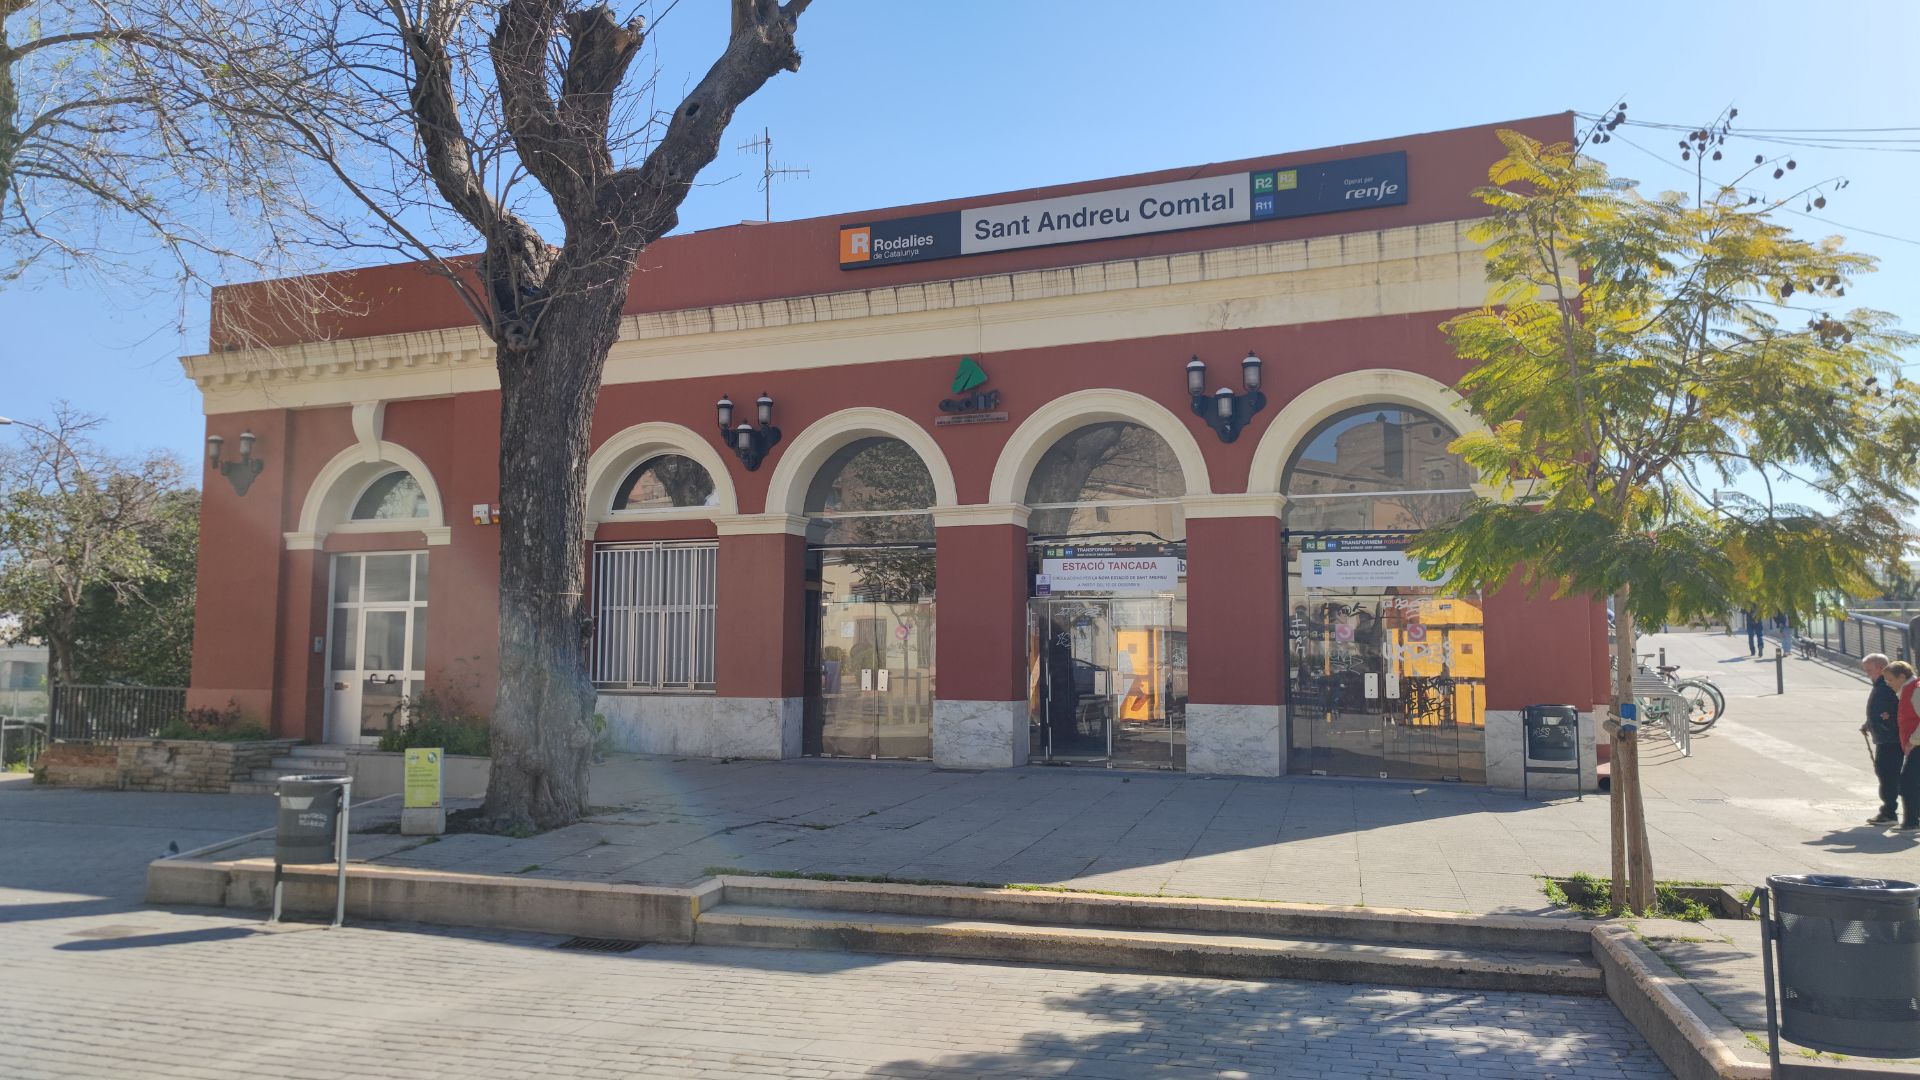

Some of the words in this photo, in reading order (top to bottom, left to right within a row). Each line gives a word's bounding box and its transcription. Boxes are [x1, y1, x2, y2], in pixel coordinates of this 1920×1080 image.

[1256, 178, 1273, 189] R2
[1343, 178, 1363, 186] Operat
[1345, 180, 1399, 200] renfe
[1255, 201, 1272, 211] R11
[974, 215, 1030, 240] Sant
[1037, 207, 1130, 234] Andreu
[1139, 188, 1234, 220] Comtal
[851, 233, 869, 255] R
[873, 235, 934, 252] Rodalies
[873, 251, 882, 260] de
[884, 249, 919, 260] Catalunya
[1062, 560, 1105, 571] ESTACIÓ
[1108, 561, 1157, 570] TANCADA
[1336, 559, 1359, 567] Sant
[1362, 558, 1399, 567] Andreu
